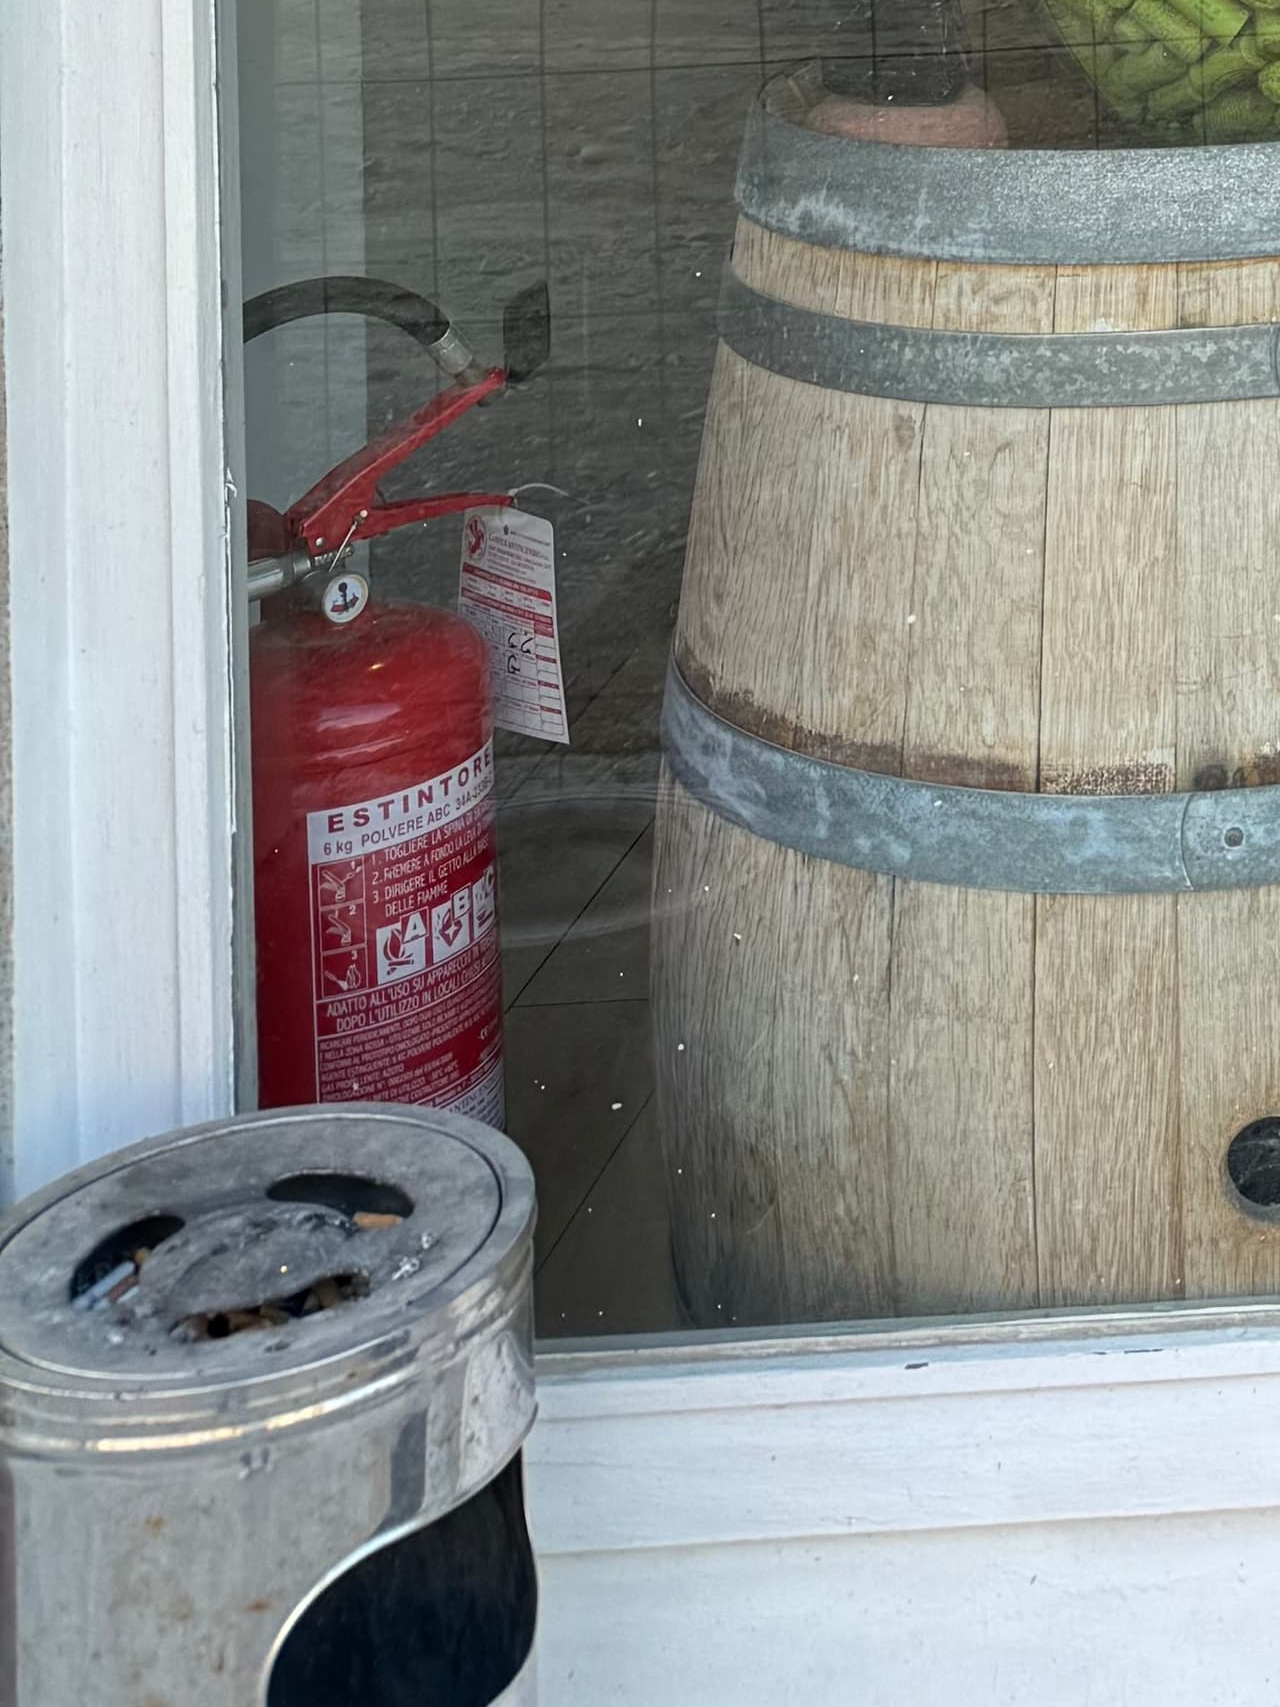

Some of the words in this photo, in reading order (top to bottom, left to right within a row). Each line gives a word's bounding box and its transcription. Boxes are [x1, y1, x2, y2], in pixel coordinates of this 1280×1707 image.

[327, 747, 490, 834] ESTINTORE
[323, 842, 332, 856] 6
[336, 840, 353, 855] kg
[361, 816, 424, 847] POLVERE
[427, 803, 450, 826] ABC
[384, 835, 429, 862] TOGLIERE
[431, 828, 442, 845] LA
[431, 841, 454, 863] FONDO
[384, 873, 426, 900] DIRIGERE
[438, 855, 462, 879] GETTO
[385, 894, 415, 918] DELLE
[417, 880, 448, 906] FIAMME
[453, 887, 470, 918] B
[402, 912, 428, 944] A
[327, 996, 367, 1018] ADATTO
[370, 981, 410, 1005] ALL'USO
[413, 977, 425, 993] SU
[336, 1014, 366, 1033] DOPO
[369, 996, 419, 1024] L'UTILIZZO
[422, 990, 431, 1004] IN
[433, 975, 460, 1000] LOCALI
